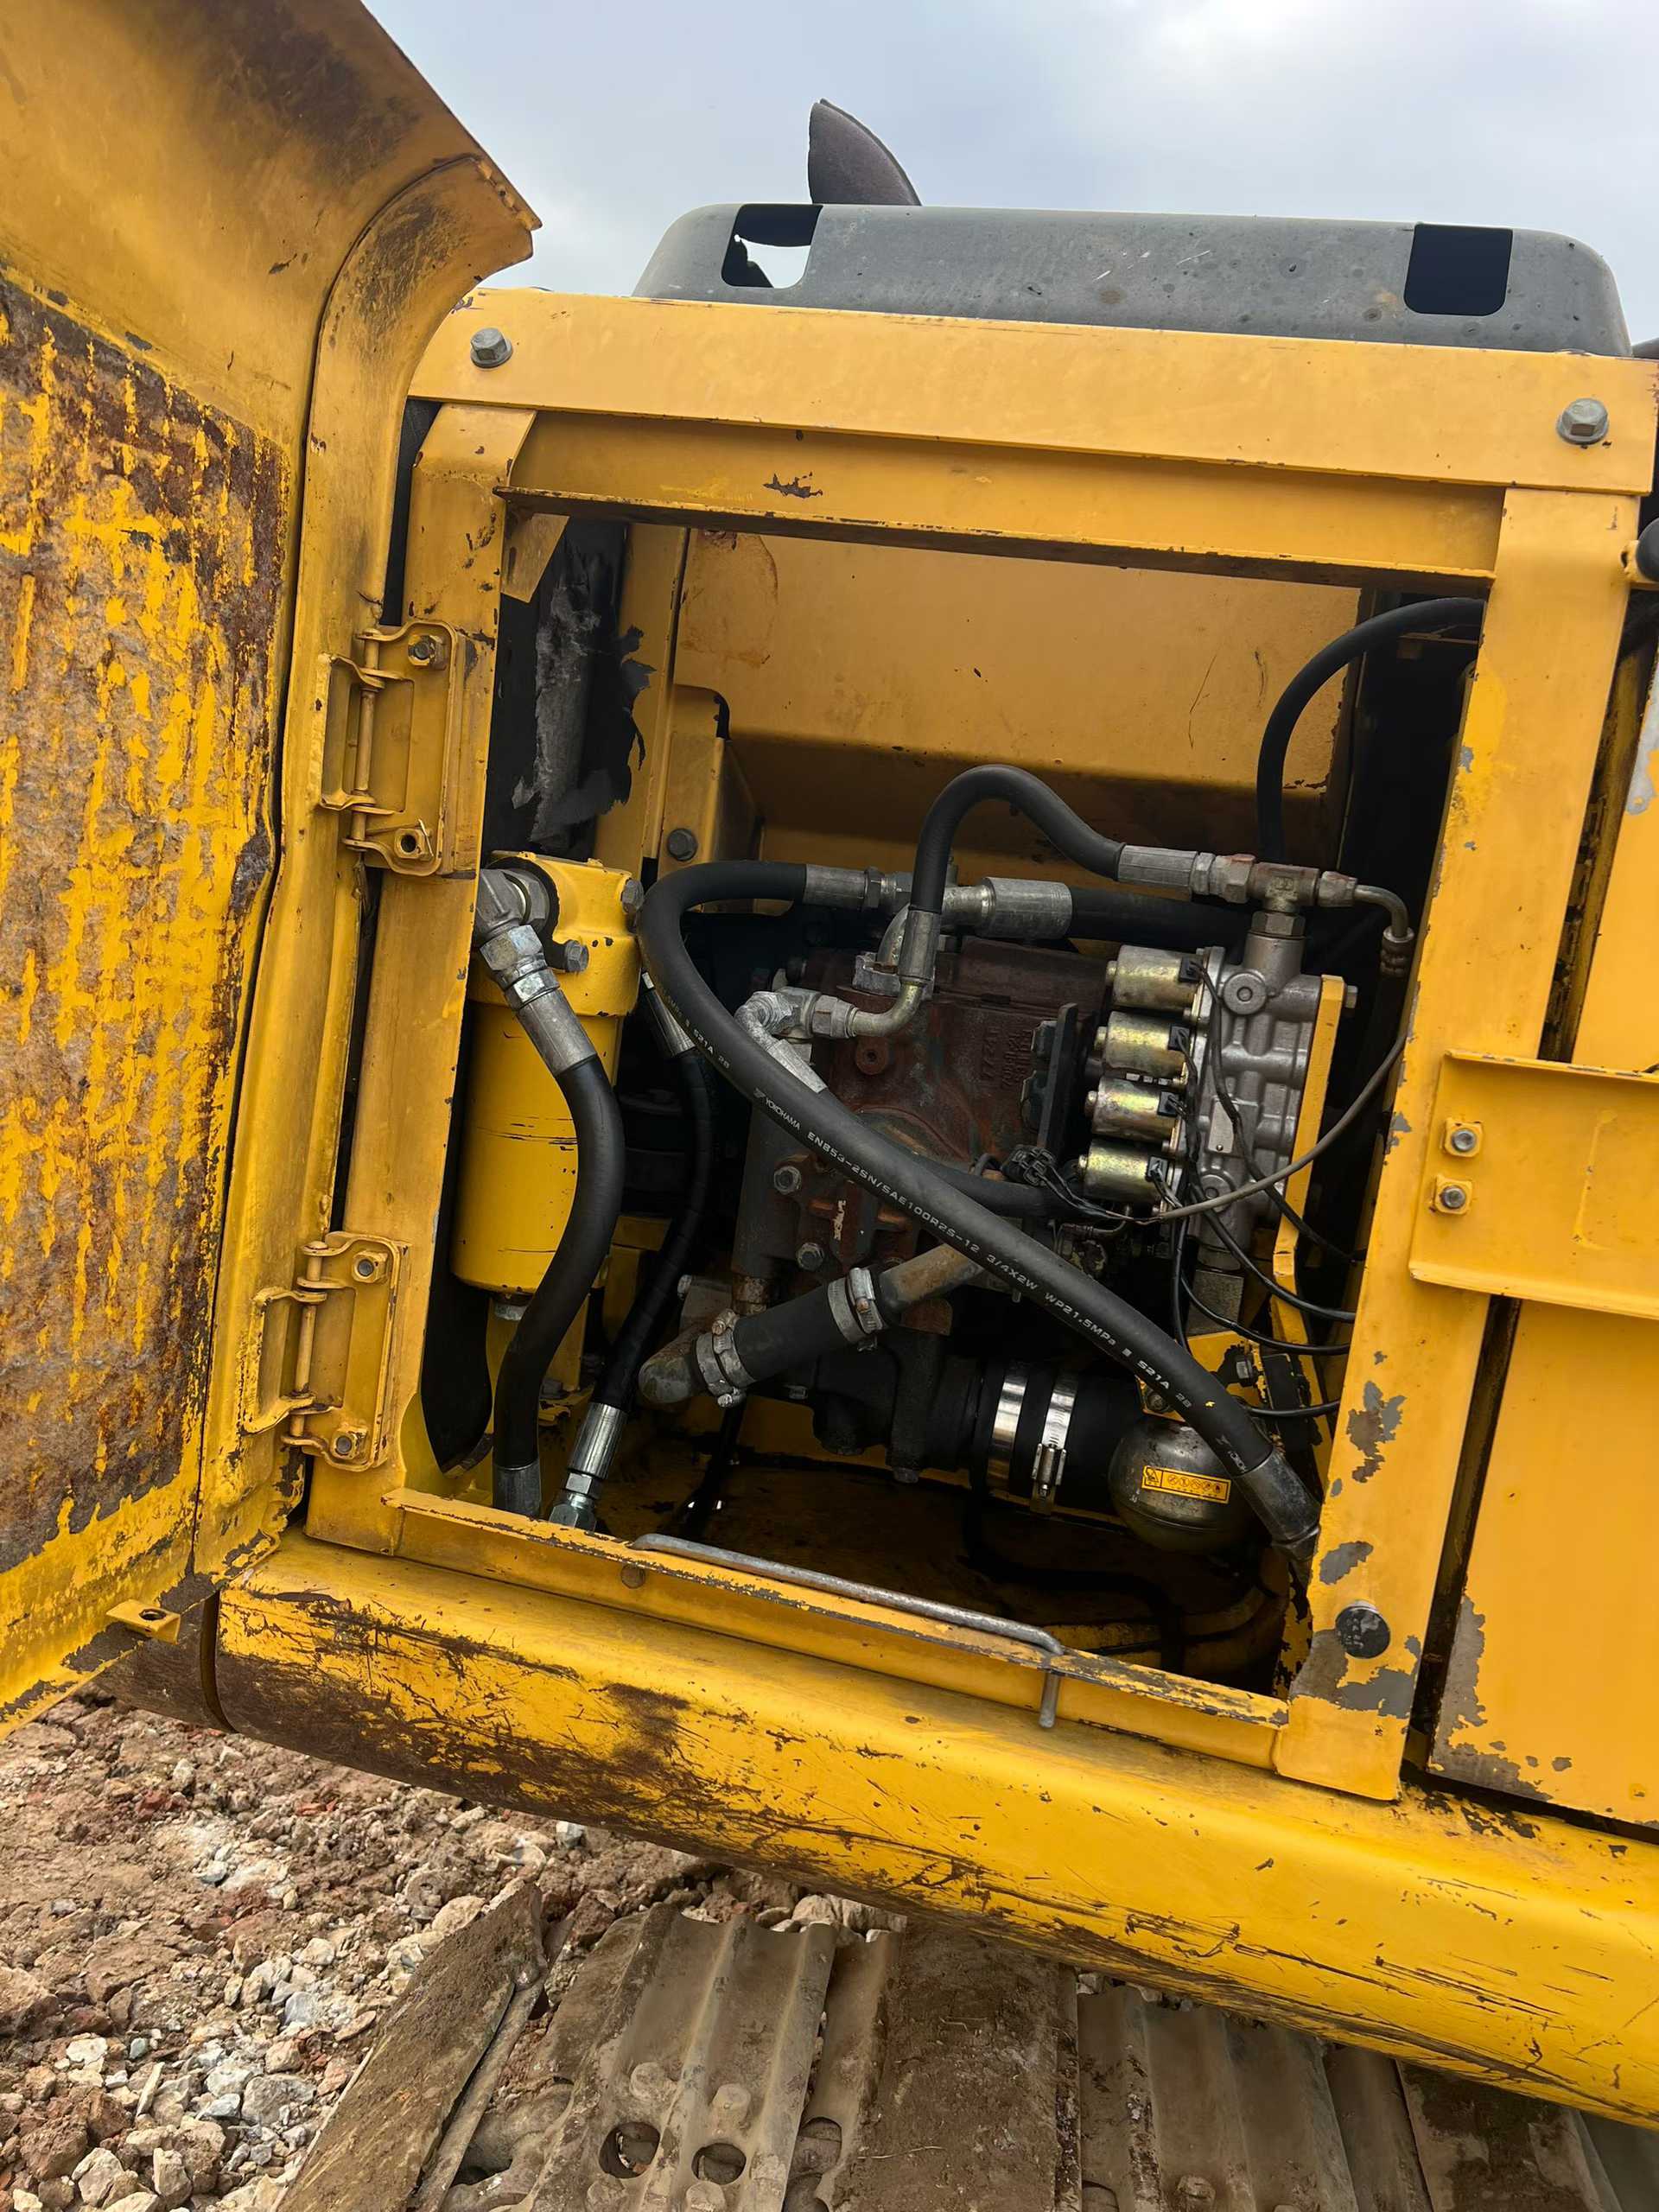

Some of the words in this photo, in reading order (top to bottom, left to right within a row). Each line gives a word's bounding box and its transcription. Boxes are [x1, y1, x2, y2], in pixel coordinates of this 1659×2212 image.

[765, 1097, 801, 1130] YOKOHAMA
[986, 1254, 1039, 1291] 3/4X2W
[1044, 1292, 1116, 1346] WP21.5MPa
[1137, 1359, 1170, 1389] S21A
